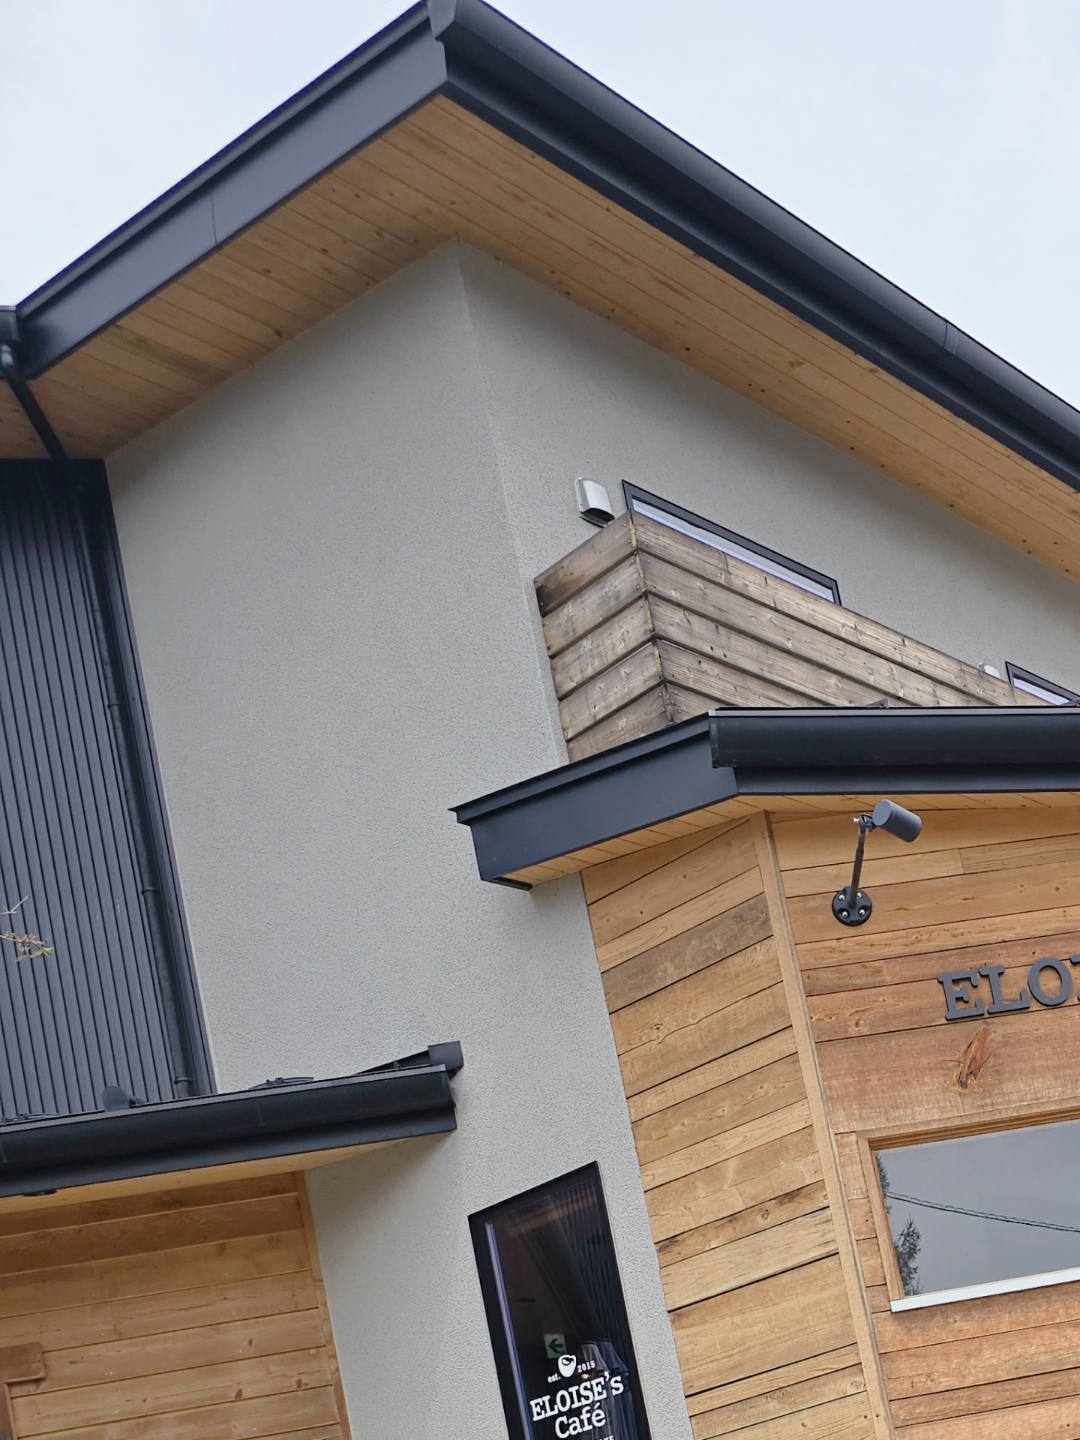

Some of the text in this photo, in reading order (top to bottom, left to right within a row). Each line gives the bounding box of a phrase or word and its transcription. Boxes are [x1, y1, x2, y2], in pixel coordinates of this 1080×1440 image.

[547, 1360, 596, 1383] est. 2015
[529, 1371, 624, 1421] ELOISE's
[555, 1402, 606, 1439] Café
